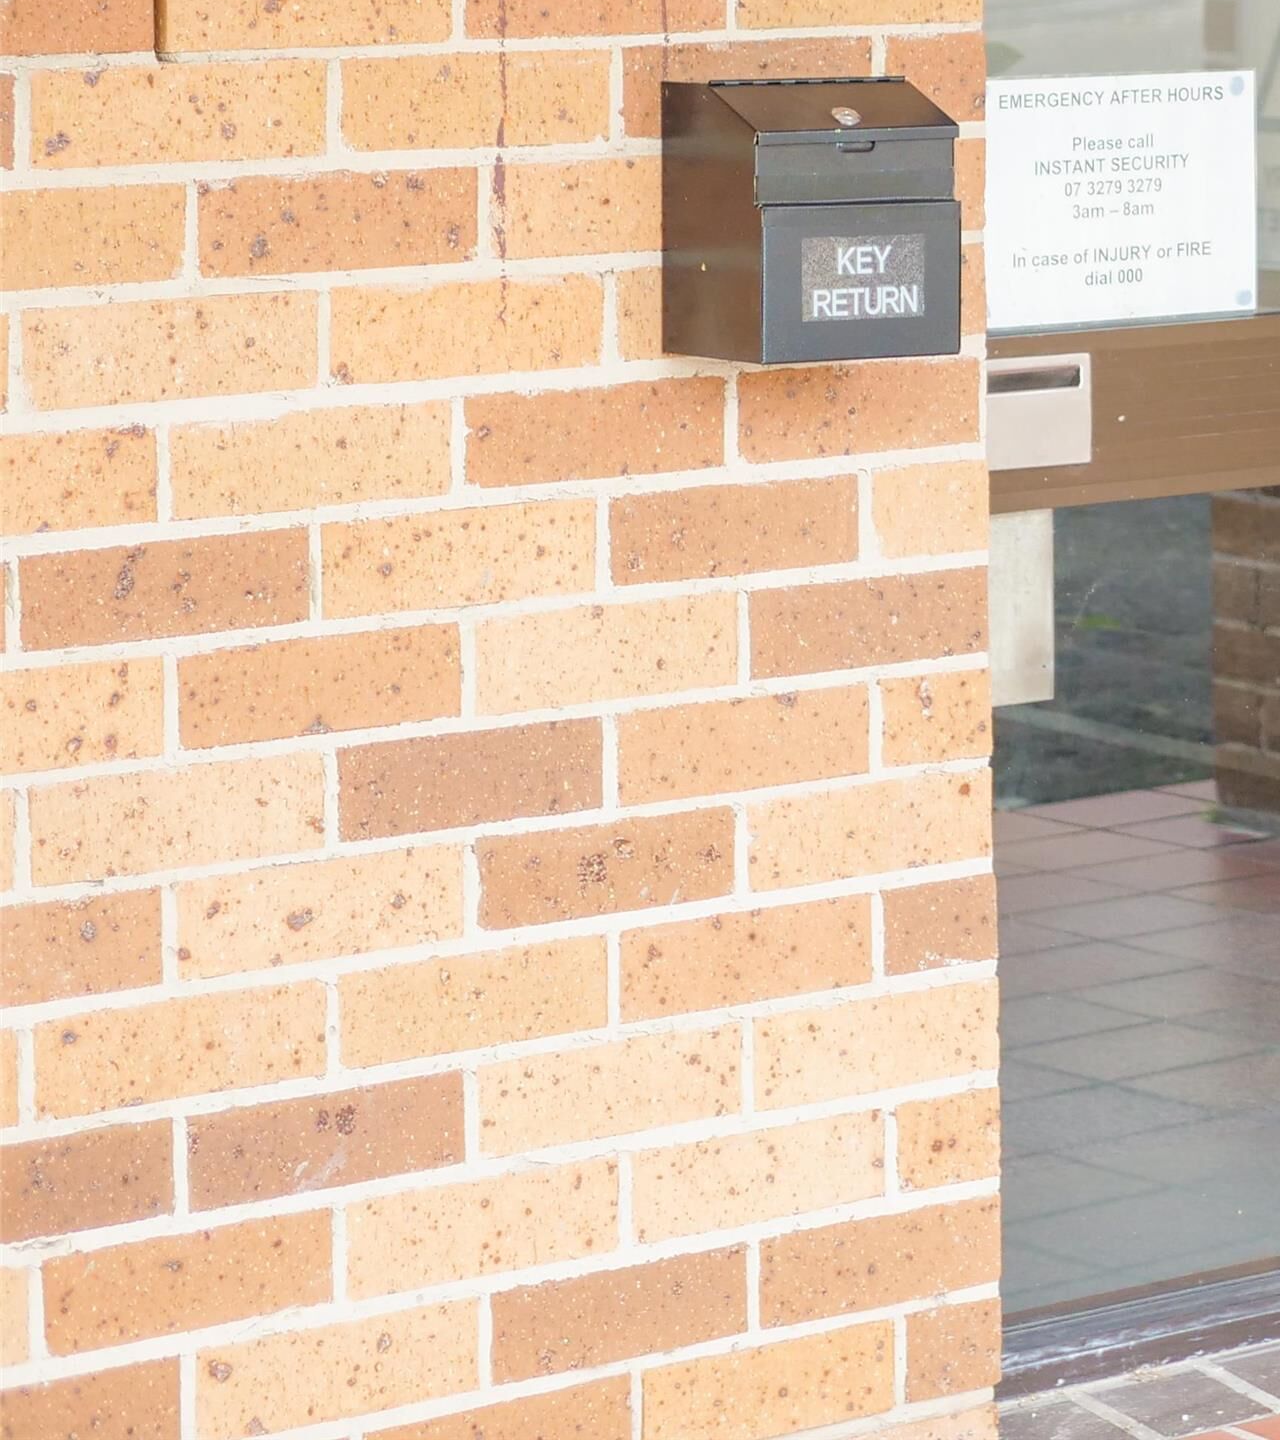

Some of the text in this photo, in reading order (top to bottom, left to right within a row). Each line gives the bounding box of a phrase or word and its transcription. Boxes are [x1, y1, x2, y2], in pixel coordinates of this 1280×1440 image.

[998, 85, 1224, 110] EMERGENCY AFTER HOURS
[1072, 133, 1154, 152] Please call
[1034, 153, 1189, 177] INSTANT SECURITY
[1064, 177, 1163, 197] 07 3279 3279
[1072, 204, 1105, 220] 3am
[1122, 200, 1155, 217] 8am
[836, 244, 892, 276] KEY
[1012, 240, 1212, 269] In case of INJURY or FIRE
[1084, 267, 1143, 286] dial 000
[812, 284, 918, 318] RETURN
